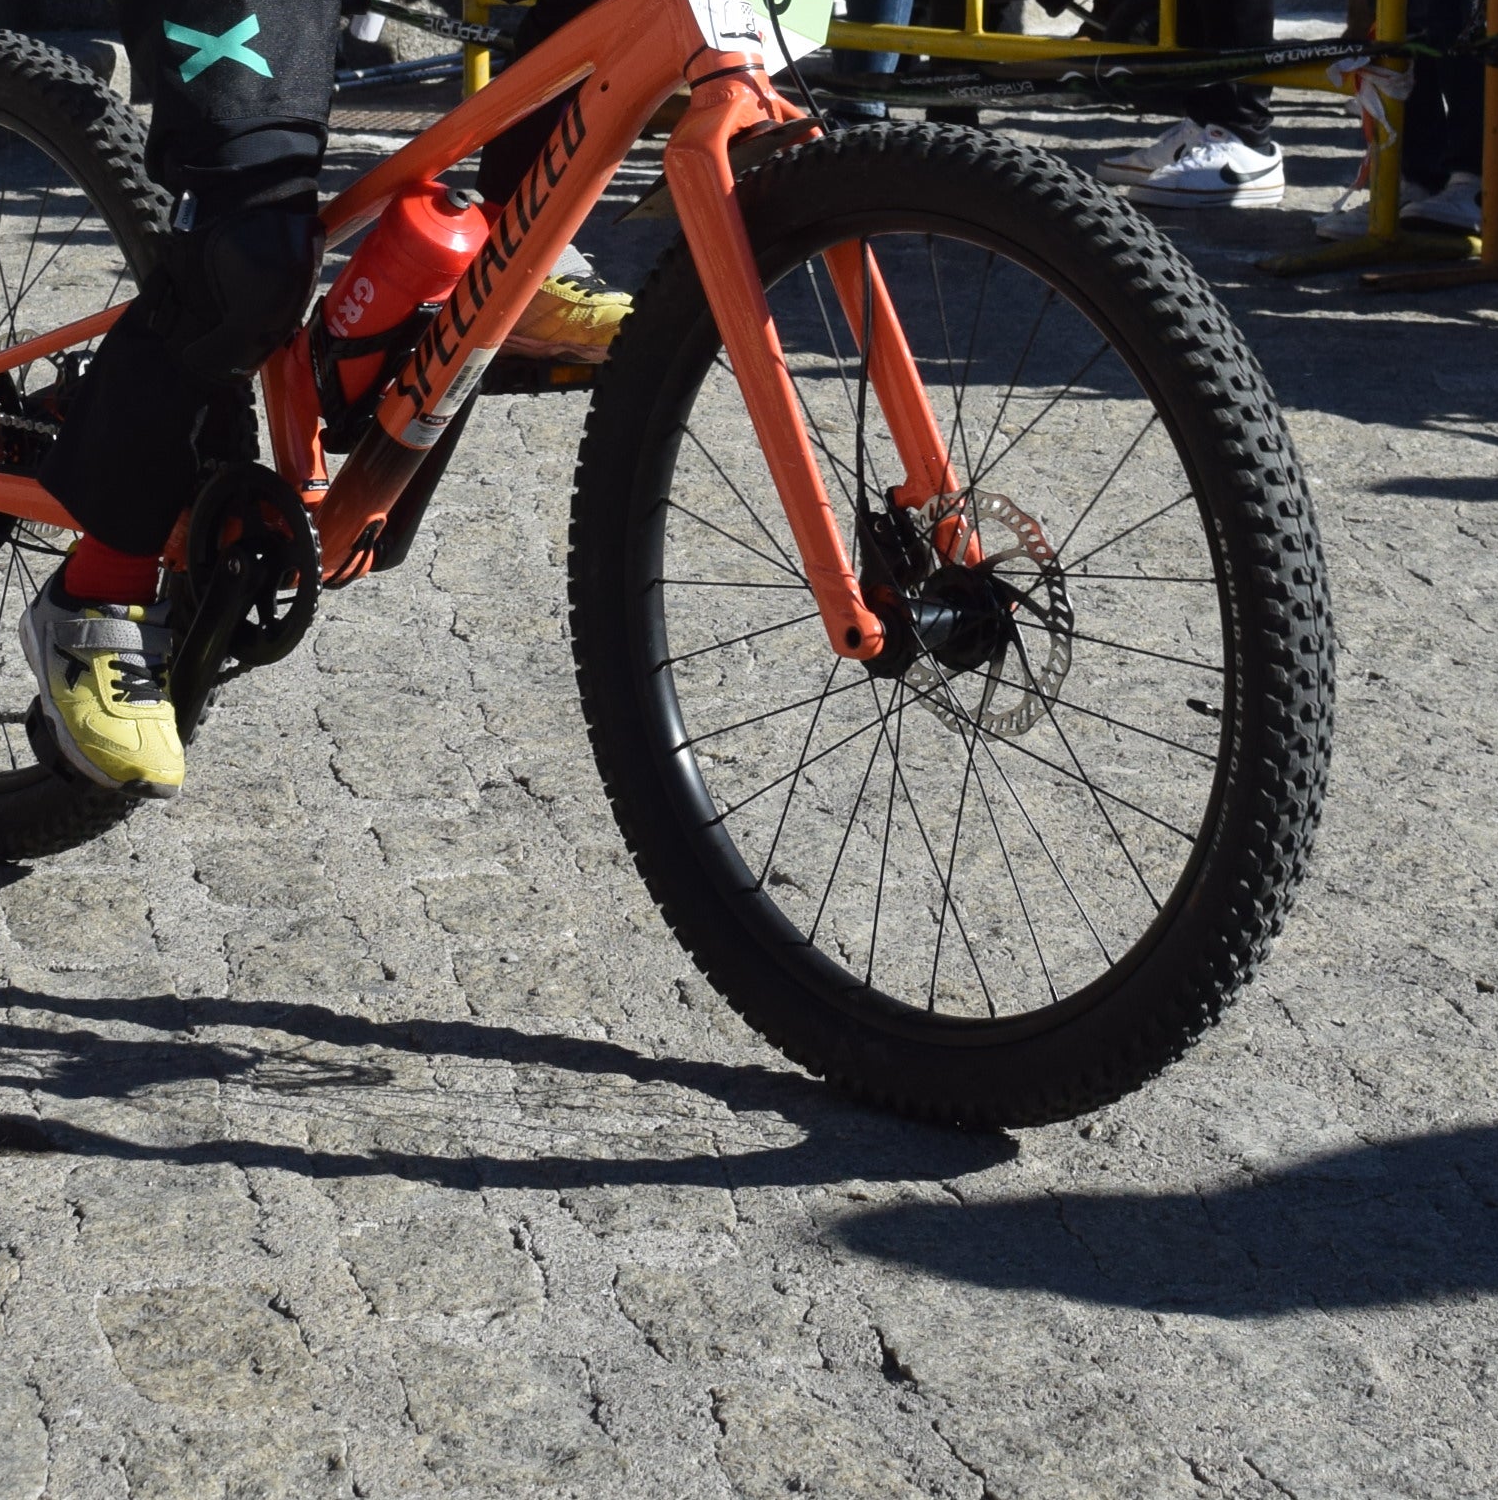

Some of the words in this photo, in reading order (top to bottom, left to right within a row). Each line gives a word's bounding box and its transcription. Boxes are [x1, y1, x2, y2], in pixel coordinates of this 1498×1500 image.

[397, 101, 587, 412] SPECIALIZED
[1214, 517, 1242, 641] GROUND
[1227, 652, 1244, 787] CONTROL
